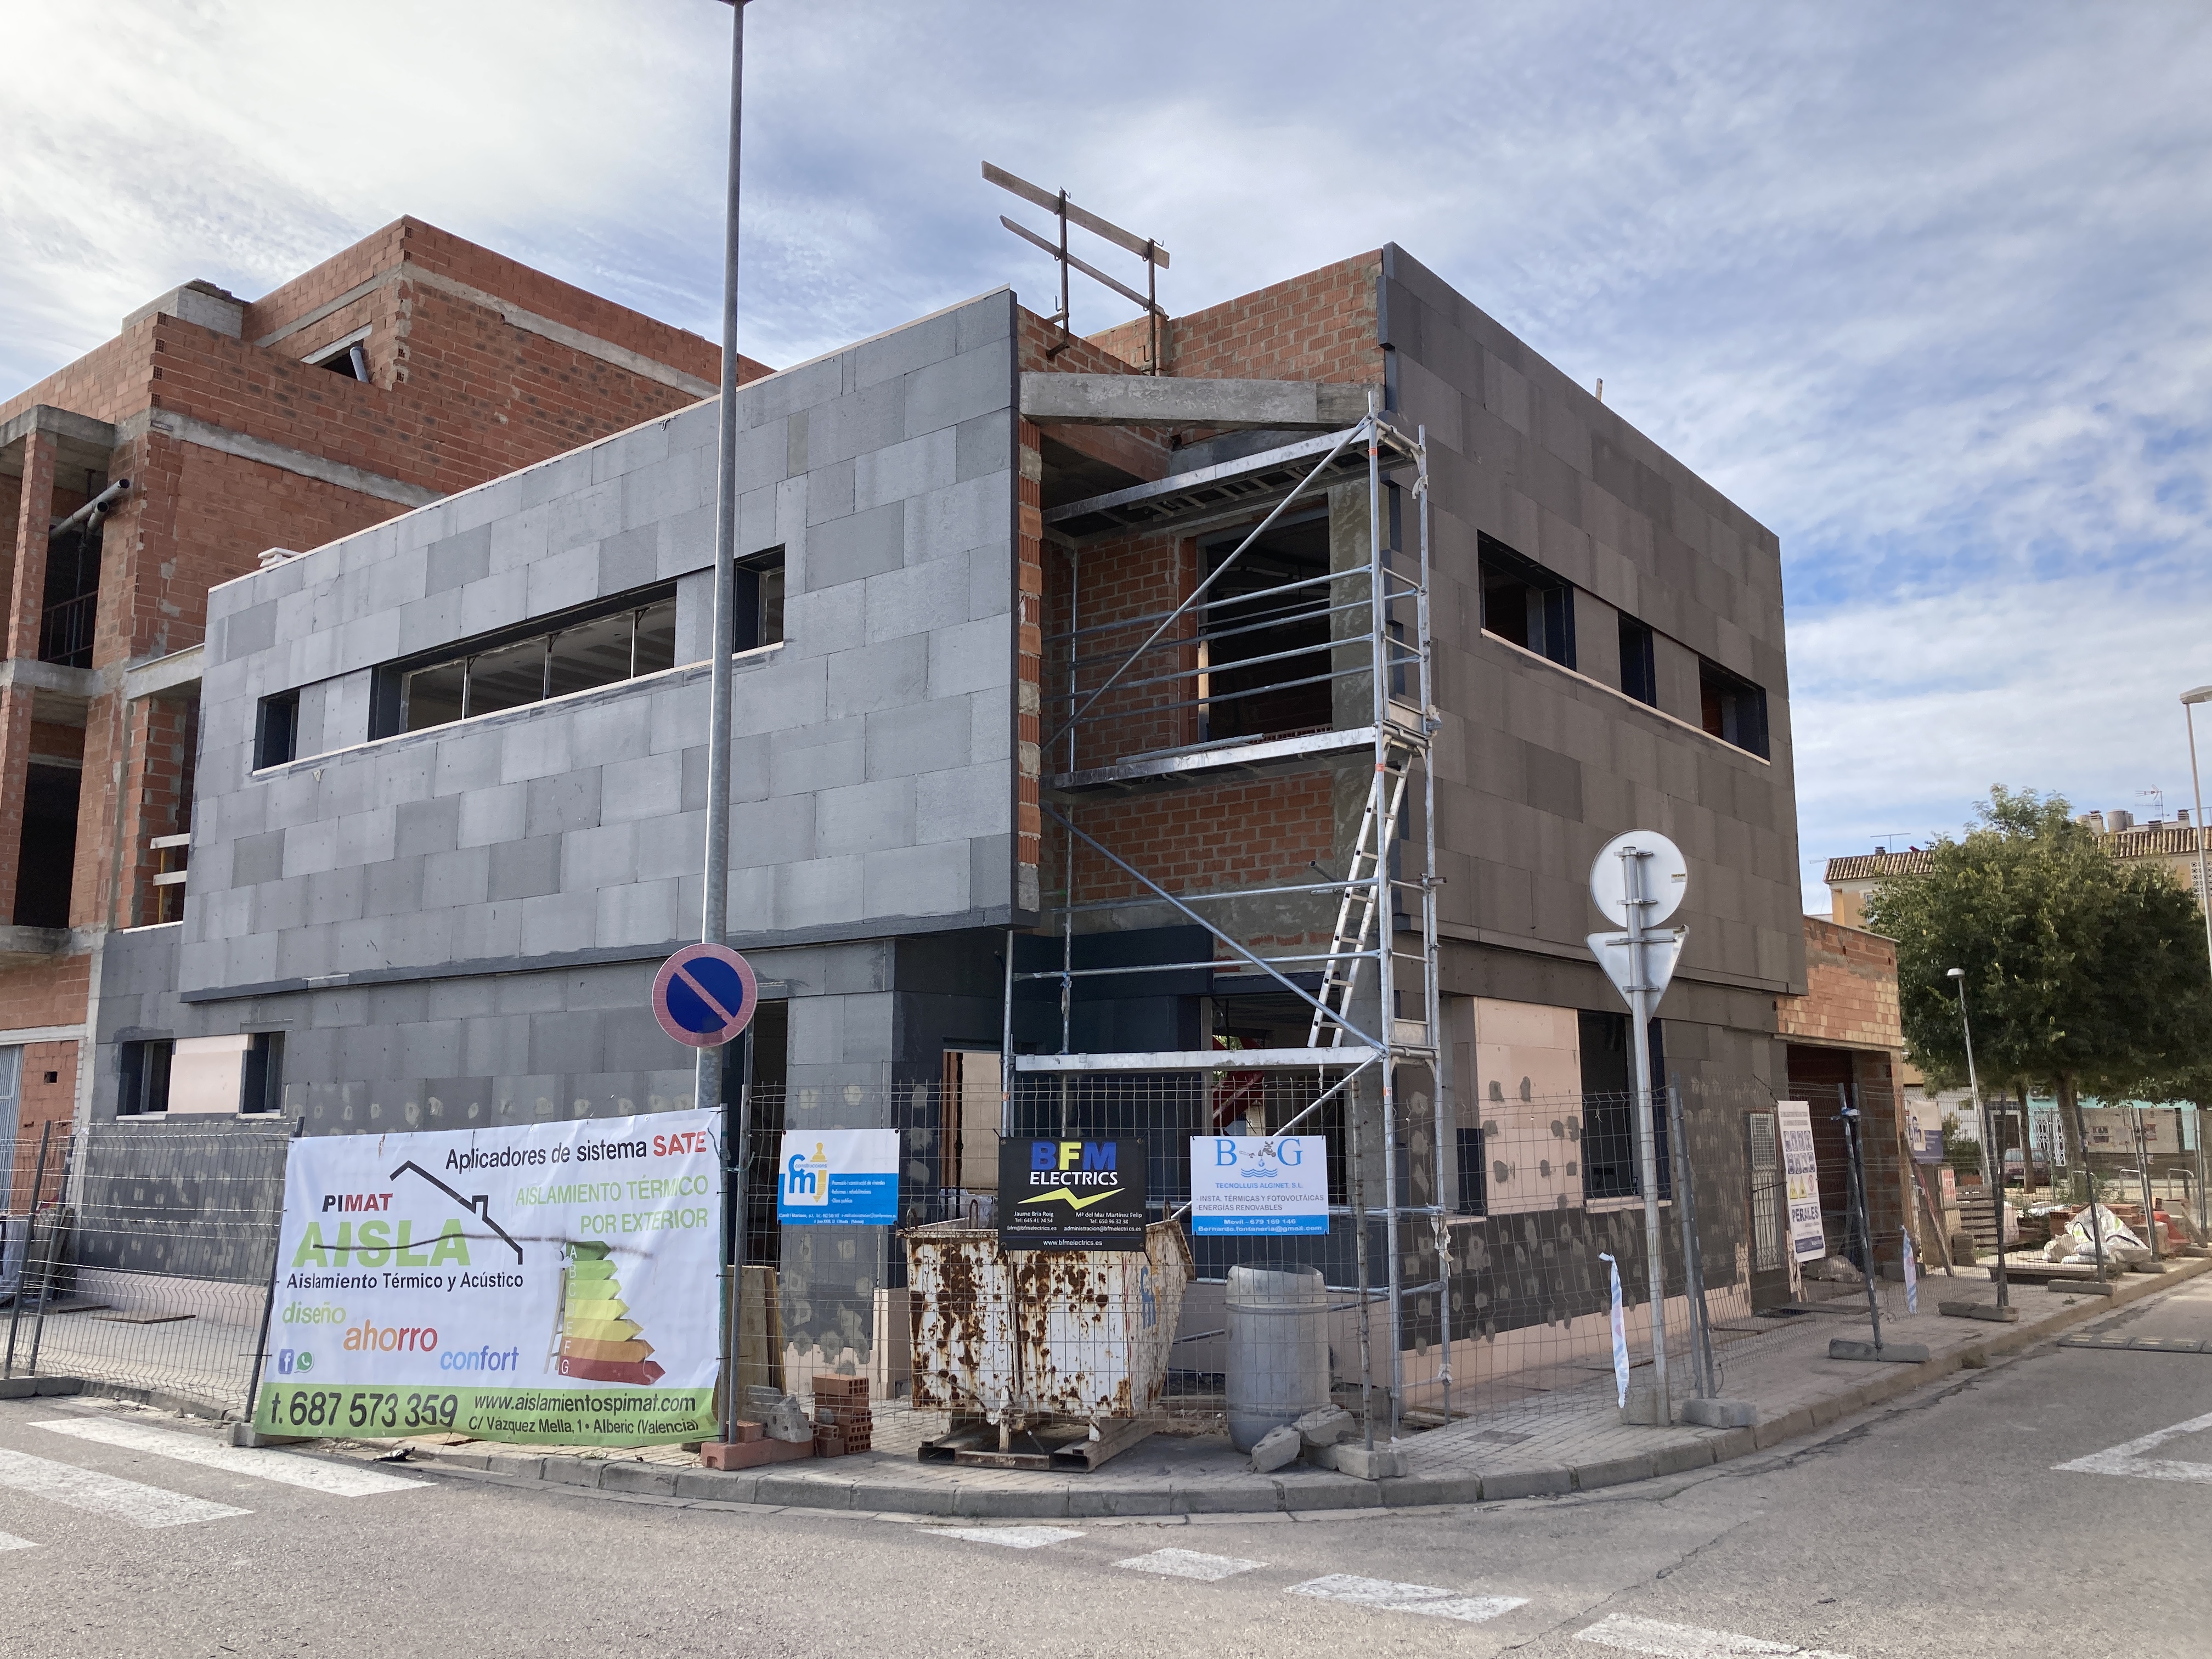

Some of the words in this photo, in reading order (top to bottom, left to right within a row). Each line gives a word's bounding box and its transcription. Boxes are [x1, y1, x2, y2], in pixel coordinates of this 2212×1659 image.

[445, 1146, 546, 1174] Aplicadores
[551, 1142, 570, 1164] de
[577, 1139, 647, 1162] sistema
[653, 1131, 706, 1157] SATE
[1031, 1141, 1116, 1170] BFM
[1214, 1139, 1237, 1166] B
[1277, 1138, 1304, 1166] G
[1030, 1171, 1118, 1185] ELECTRICS
[515, 1182, 621, 1206] AISLAMIENTO
[627, 1174, 708, 1200] TÉRMICO
[322, 1193, 393, 1212] PIMAT
[580, 1214, 617, 1234] POR
[622, 1207, 708, 1233] EXTERIOR
[1792, 1206, 1819, 1222] PERALES
[291, 1218, 471, 1267] AISLA
[570, 1245, 578, 1259] A
[569, 1264, 576, 1278] B
[287, 1273, 377, 1289] Aislamiento
[382, 1272, 443, 1288] Térmico
[447, 1276, 457, 1292] y
[460, 1272, 523, 1288] Acústico
[568, 1282, 576, 1296] C
[282, 1301, 346, 1324] diseño
[343, 1319, 438, 1352] ahorro
[566, 1322, 573, 1335] E
[563, 1340, 571, 1354] F
[440, 1345, 519, 1371] confort
[561, 1359, 569, 1374] G
[290, 1391, 342, 1426] 687
[349, 1393, 398, 1427] 573
[405, 1393, 458, 1427] 359
[475, 1392, 696, 1416] www.aislamientospimat.com
[469, 1416, 483, 1431] C/
[487, 1416, 535, 1435] Vázquez
[539, 1418, 574, 1435] Mella,
[594, 1419, 634, 1434] Alberic
[638, 1418, 699, 1435] (Valencia)
